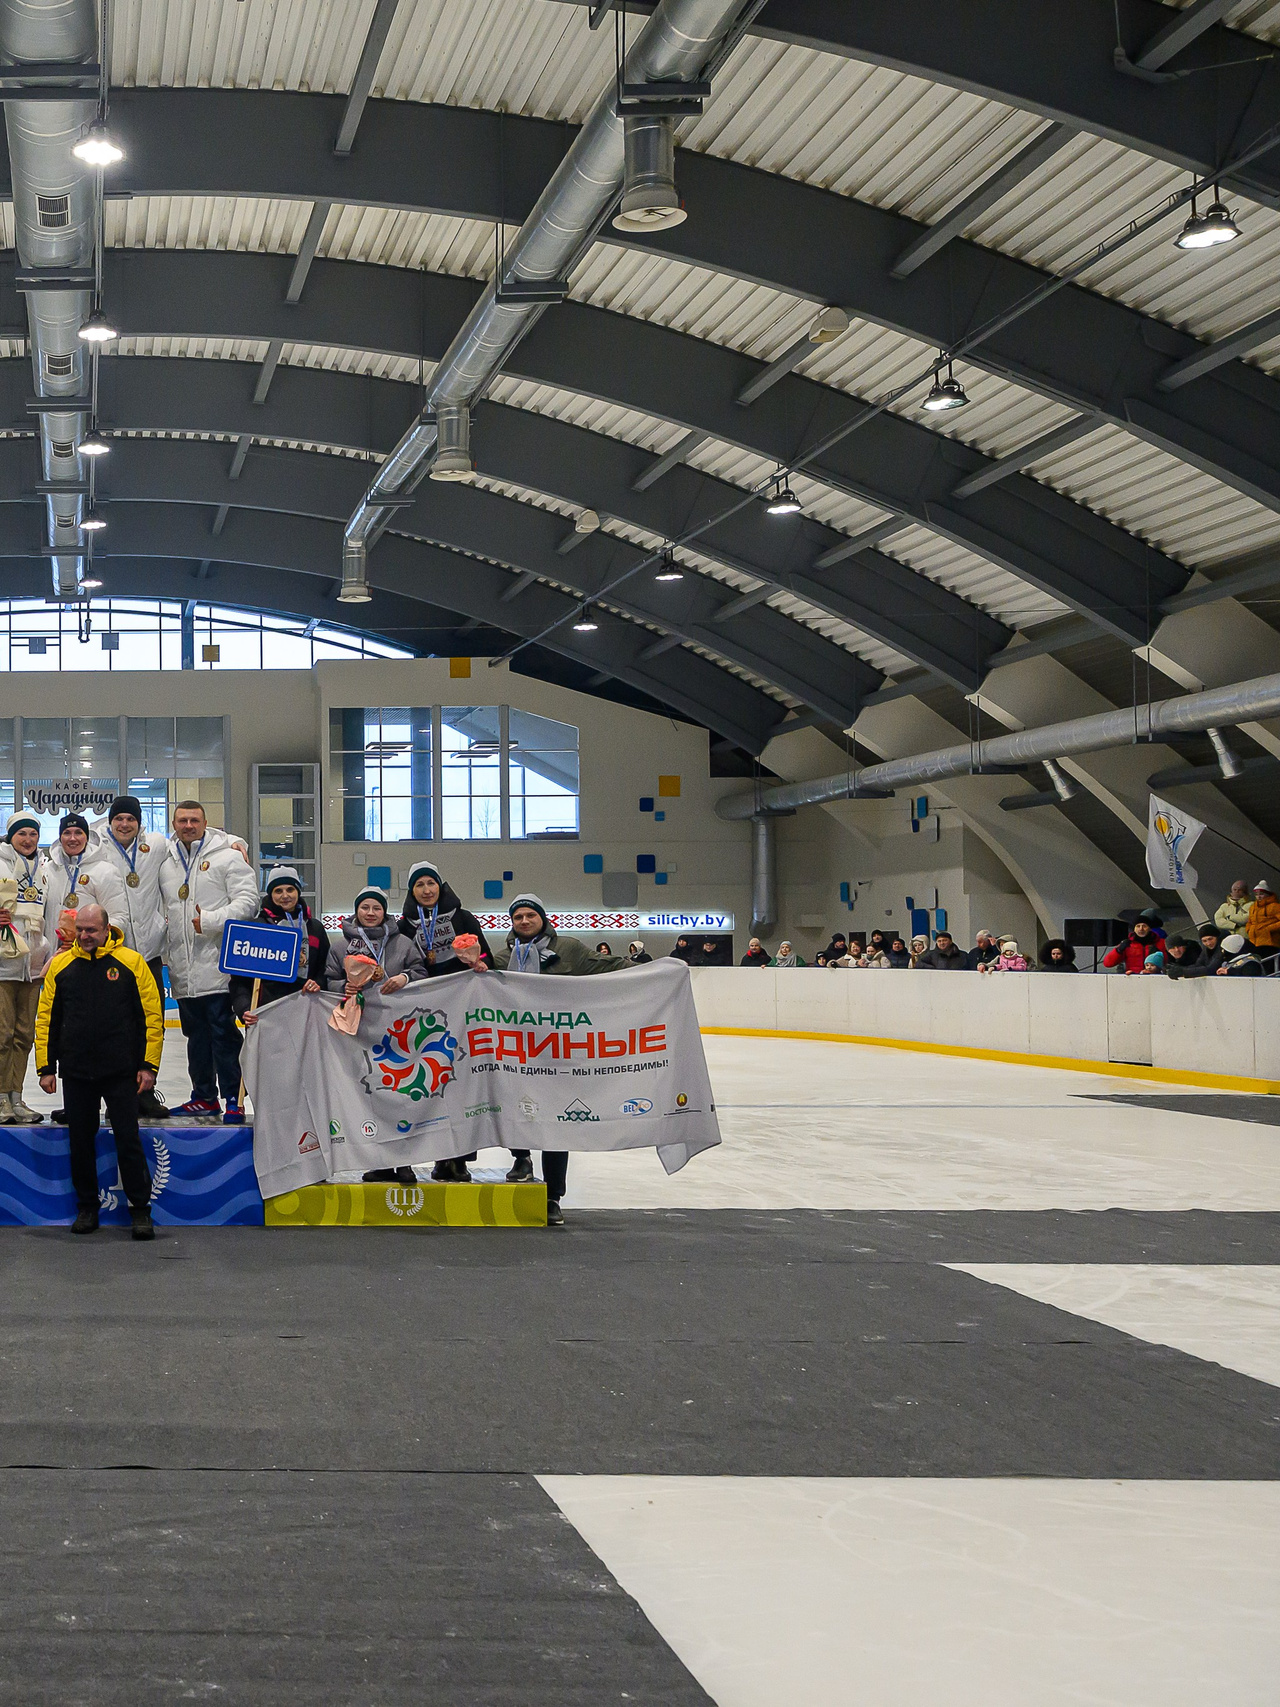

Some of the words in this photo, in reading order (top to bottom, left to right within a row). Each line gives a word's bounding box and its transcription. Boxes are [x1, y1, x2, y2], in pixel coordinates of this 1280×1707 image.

[55, 782, 88, 790] КАФЕ
[28, 789, 114, 811] Чараўніца
[648, 914, 725, 927] silichy.by
[232, 940, 288, 962] Единые
[465, 1007, 592, 1029] КОМАНДА
[467, 1024, 667, 1064] ЕДИНЫЕ
[471, 1063, 500, 1074] КОГДА
[503, 1064, 517, 1073] МЫ
[520, 1066, 557, 1076] ЕДИНЫ
[572, 1067, 591, 1076] МЫ
[594, 1059, 669, 1076] НЕПОБЕДИМЫ!
[392, 1188, 418, 1206] III
